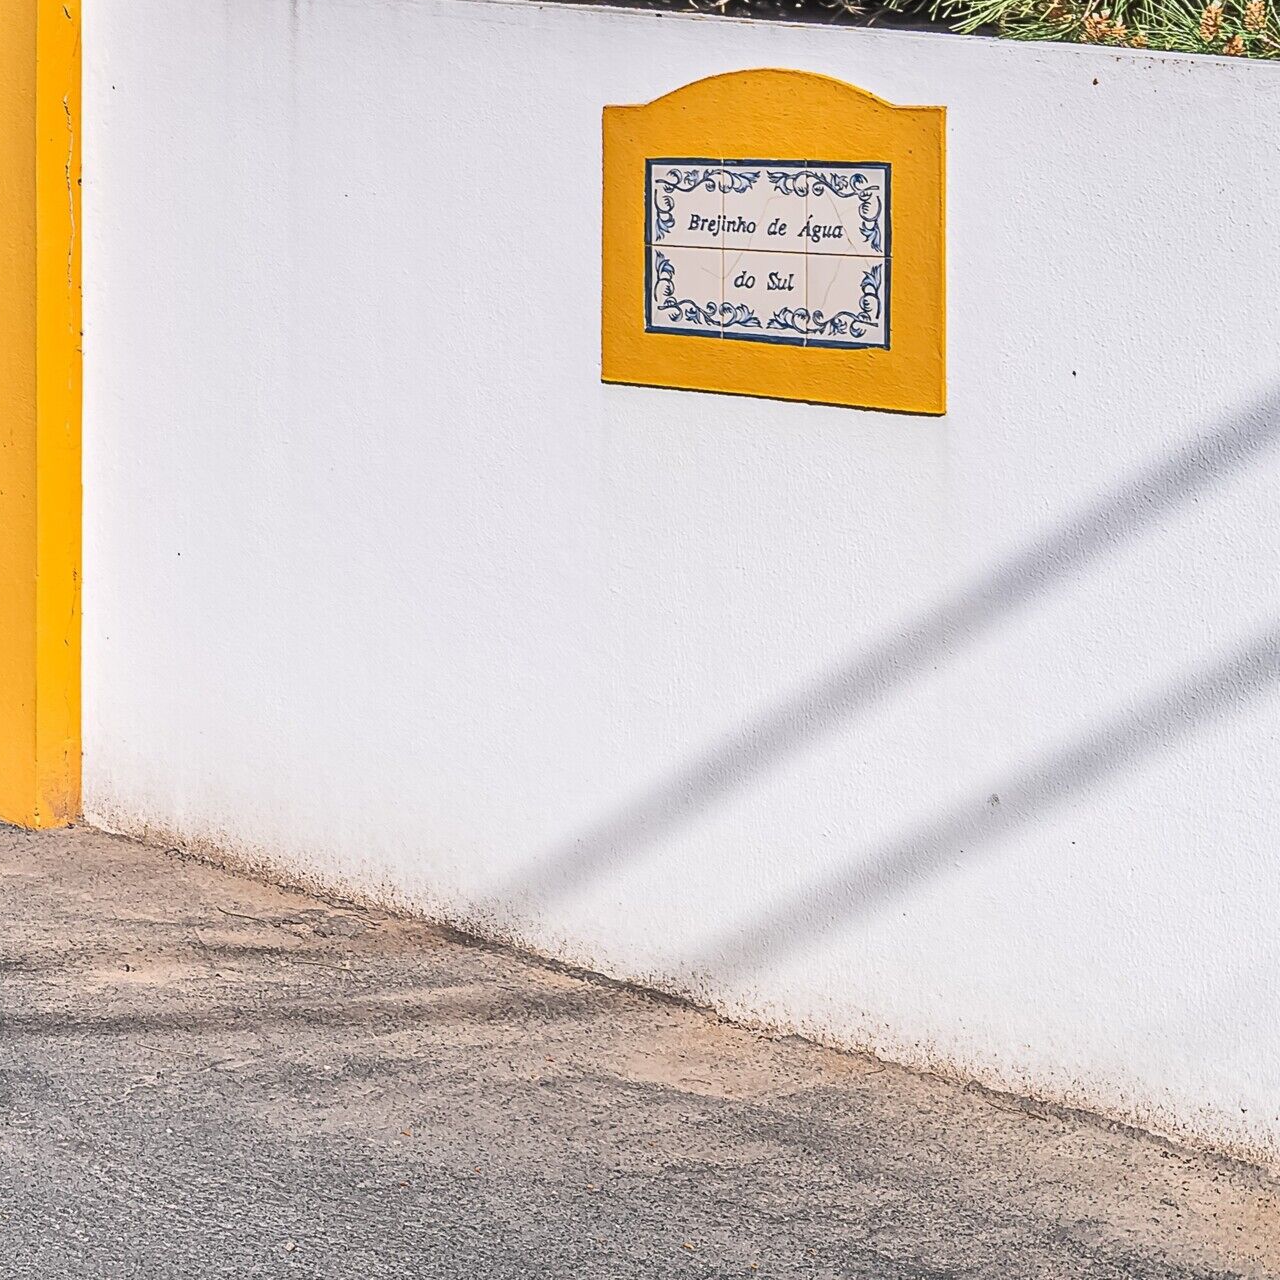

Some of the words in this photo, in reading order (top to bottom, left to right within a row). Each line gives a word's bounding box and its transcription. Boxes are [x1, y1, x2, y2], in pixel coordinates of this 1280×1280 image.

[687, 213, 756, 237] Brejinho
[767, 218, 787, 236] de
[797, 214, 844, 243] Água
[734, 270, 756, 289] do
[766, 271, 795, 292] Sul
